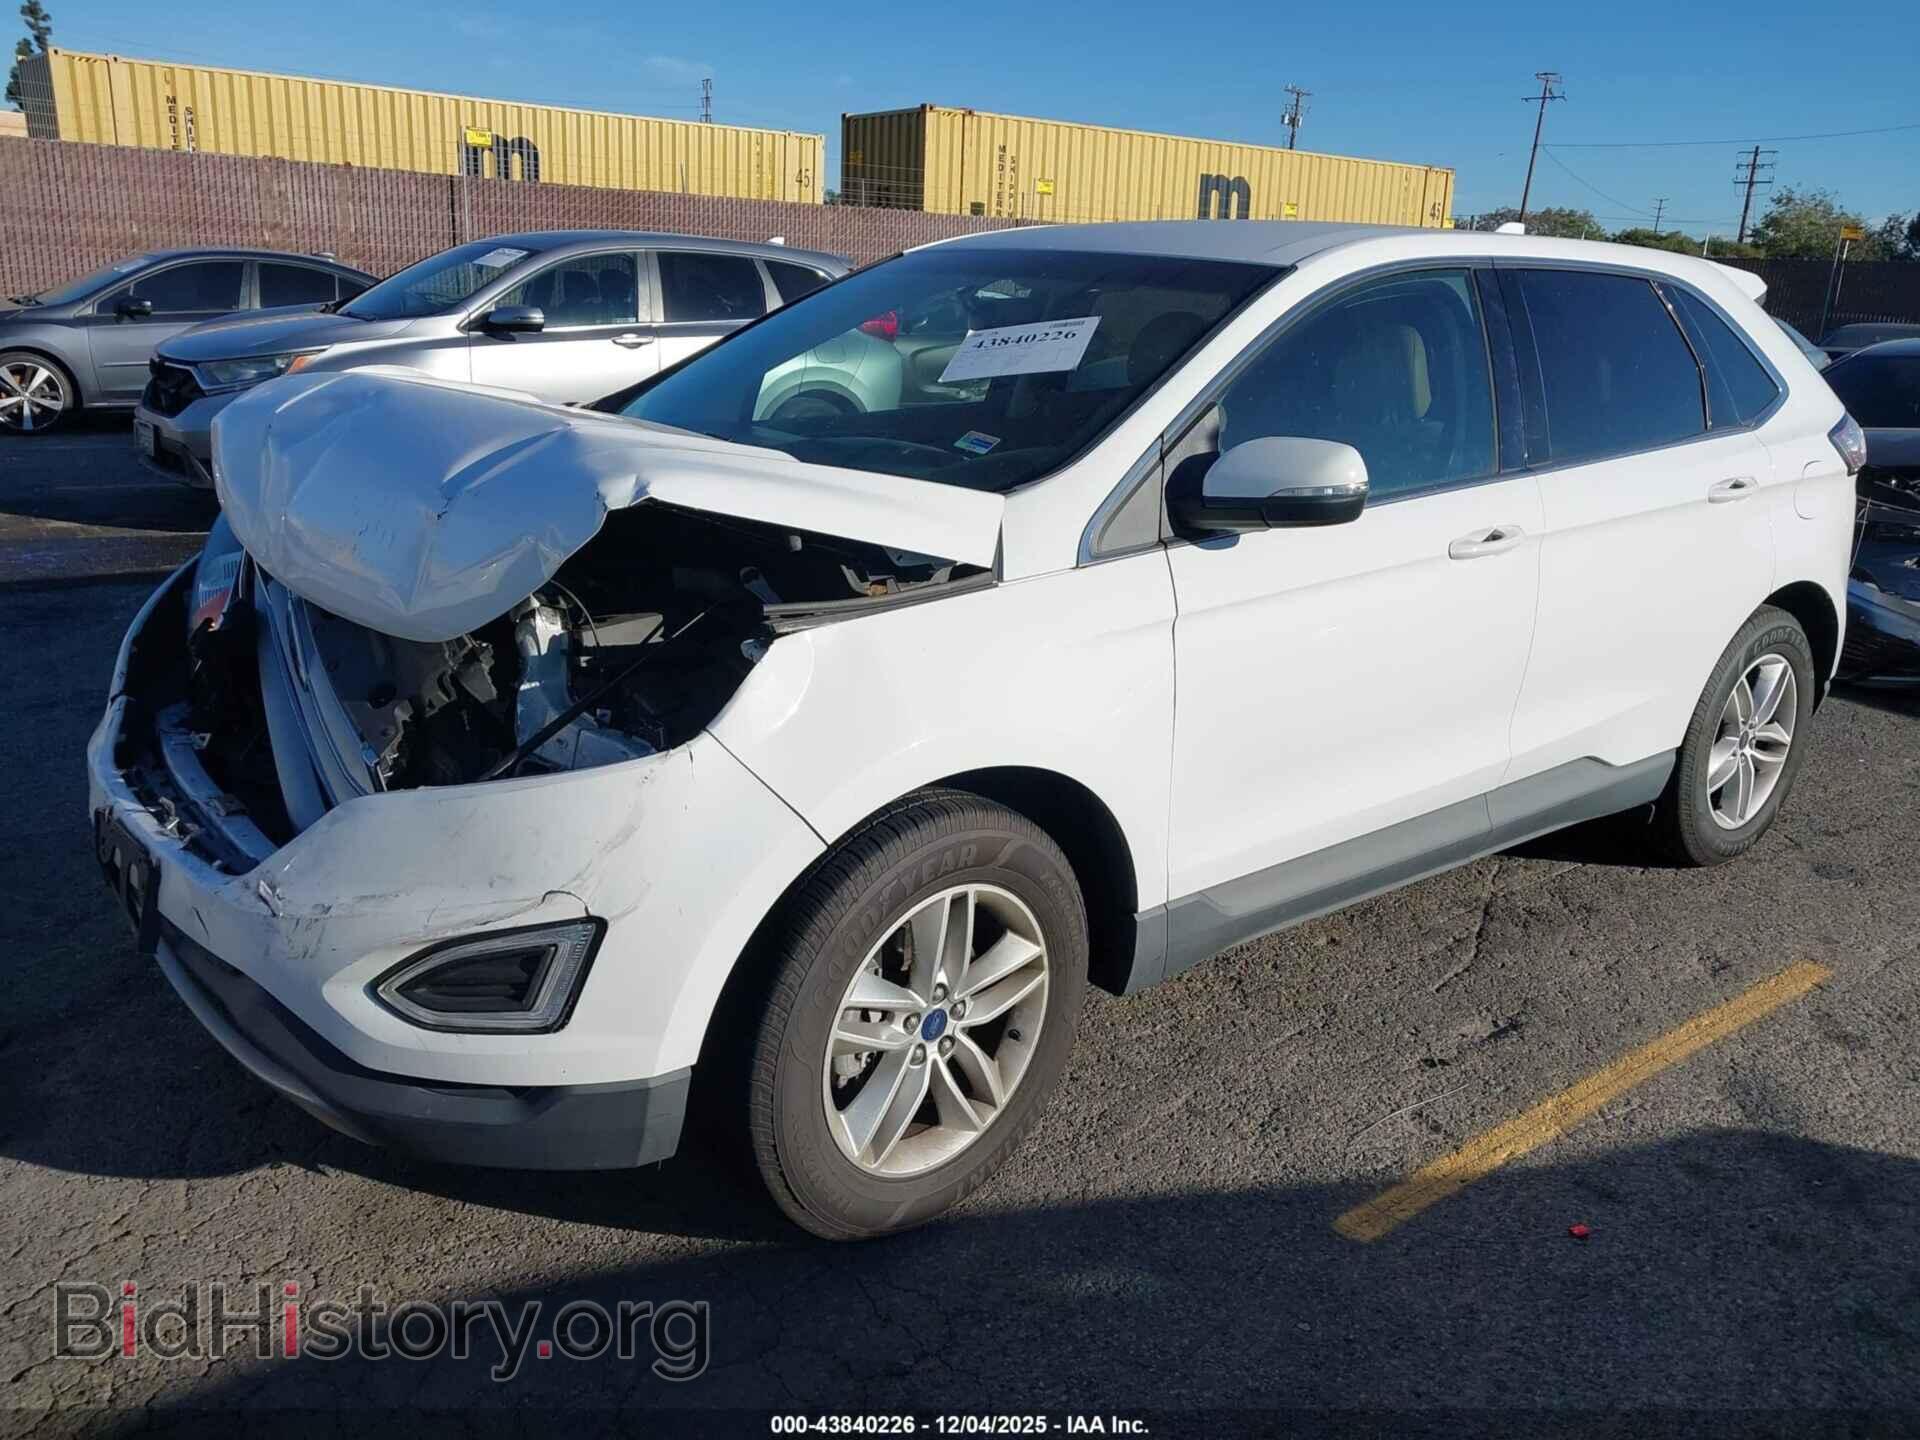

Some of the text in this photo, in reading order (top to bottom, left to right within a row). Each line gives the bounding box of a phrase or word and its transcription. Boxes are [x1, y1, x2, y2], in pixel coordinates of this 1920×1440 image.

[795, 168, 810, 188] 45
[1429, 202, 1441, 220] 45
[972, 330, 1077, 349] 43840226
